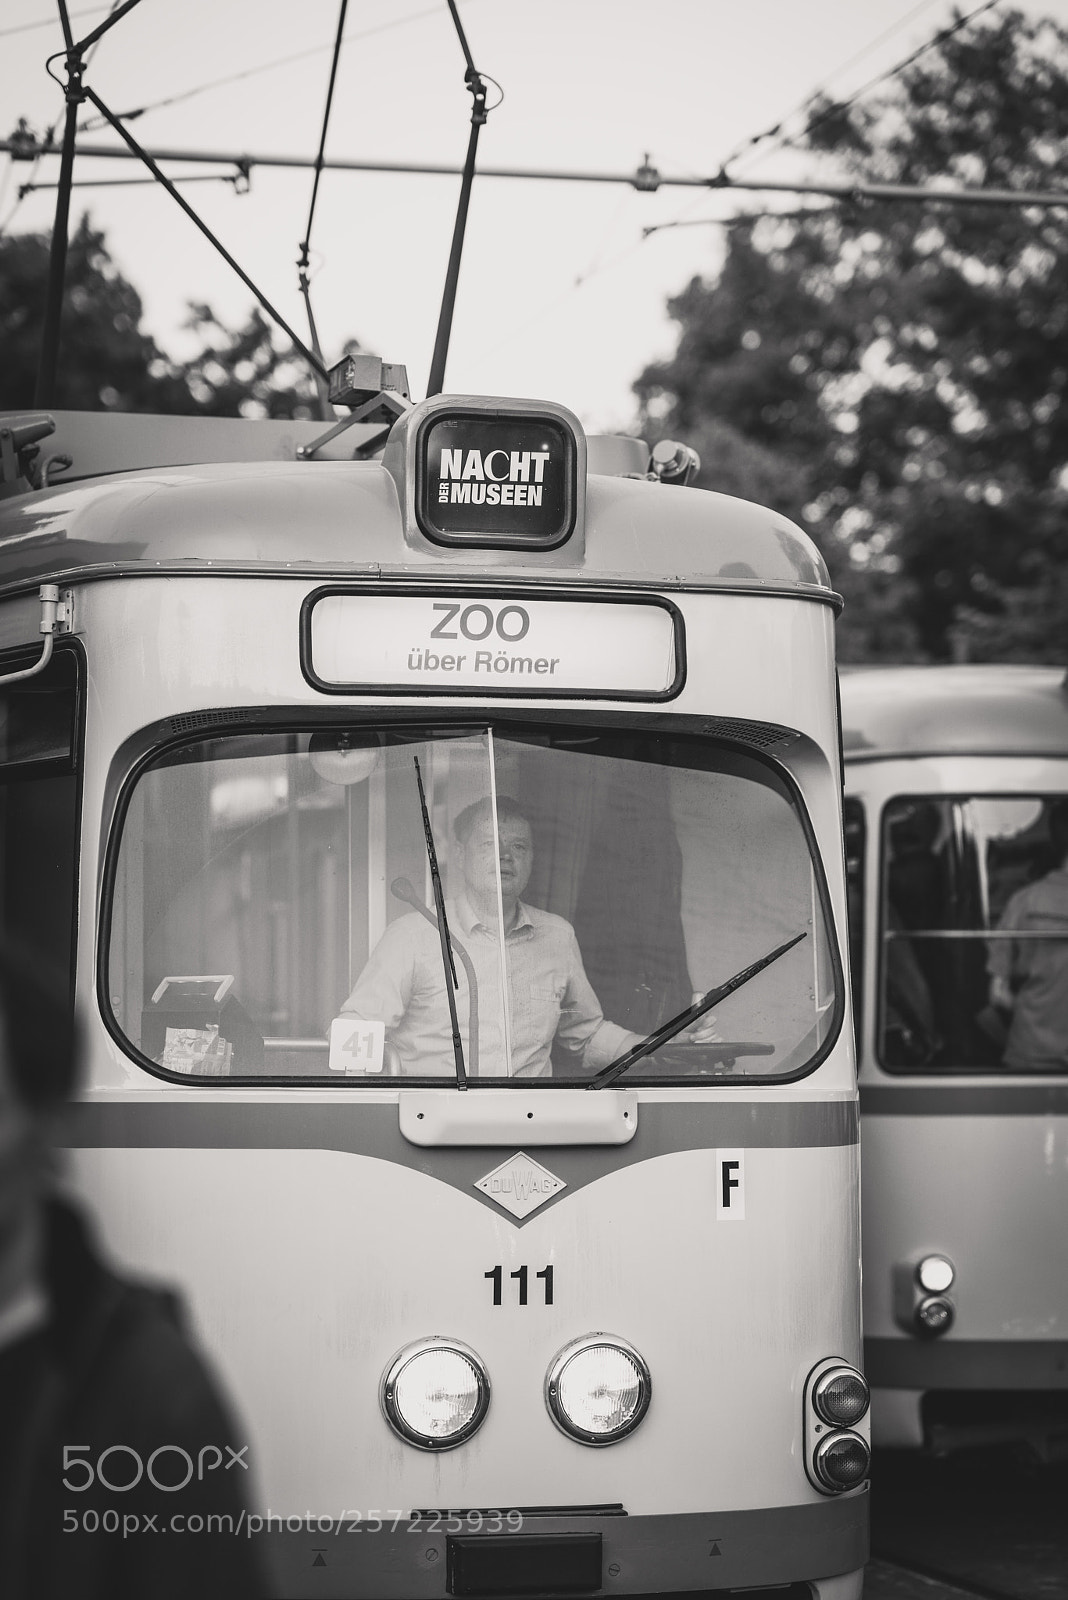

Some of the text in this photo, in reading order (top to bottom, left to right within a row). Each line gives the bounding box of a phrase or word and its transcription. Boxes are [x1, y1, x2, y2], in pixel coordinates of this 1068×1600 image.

[439, 448, 550, 482] NACHT
[438, 482, 449, 503] DER
[450, 483, 543, 506] MUSEEN
[430, 603, 530, 642] ZOO
[407, 648, 560, 674] über Römer
[341, 1032, 375, 1058] 41
[490, 1170, 552, 1201] DUWAG
[722, 1161, 739, 1207] F
[484, 1265, 553, 1305] 111
